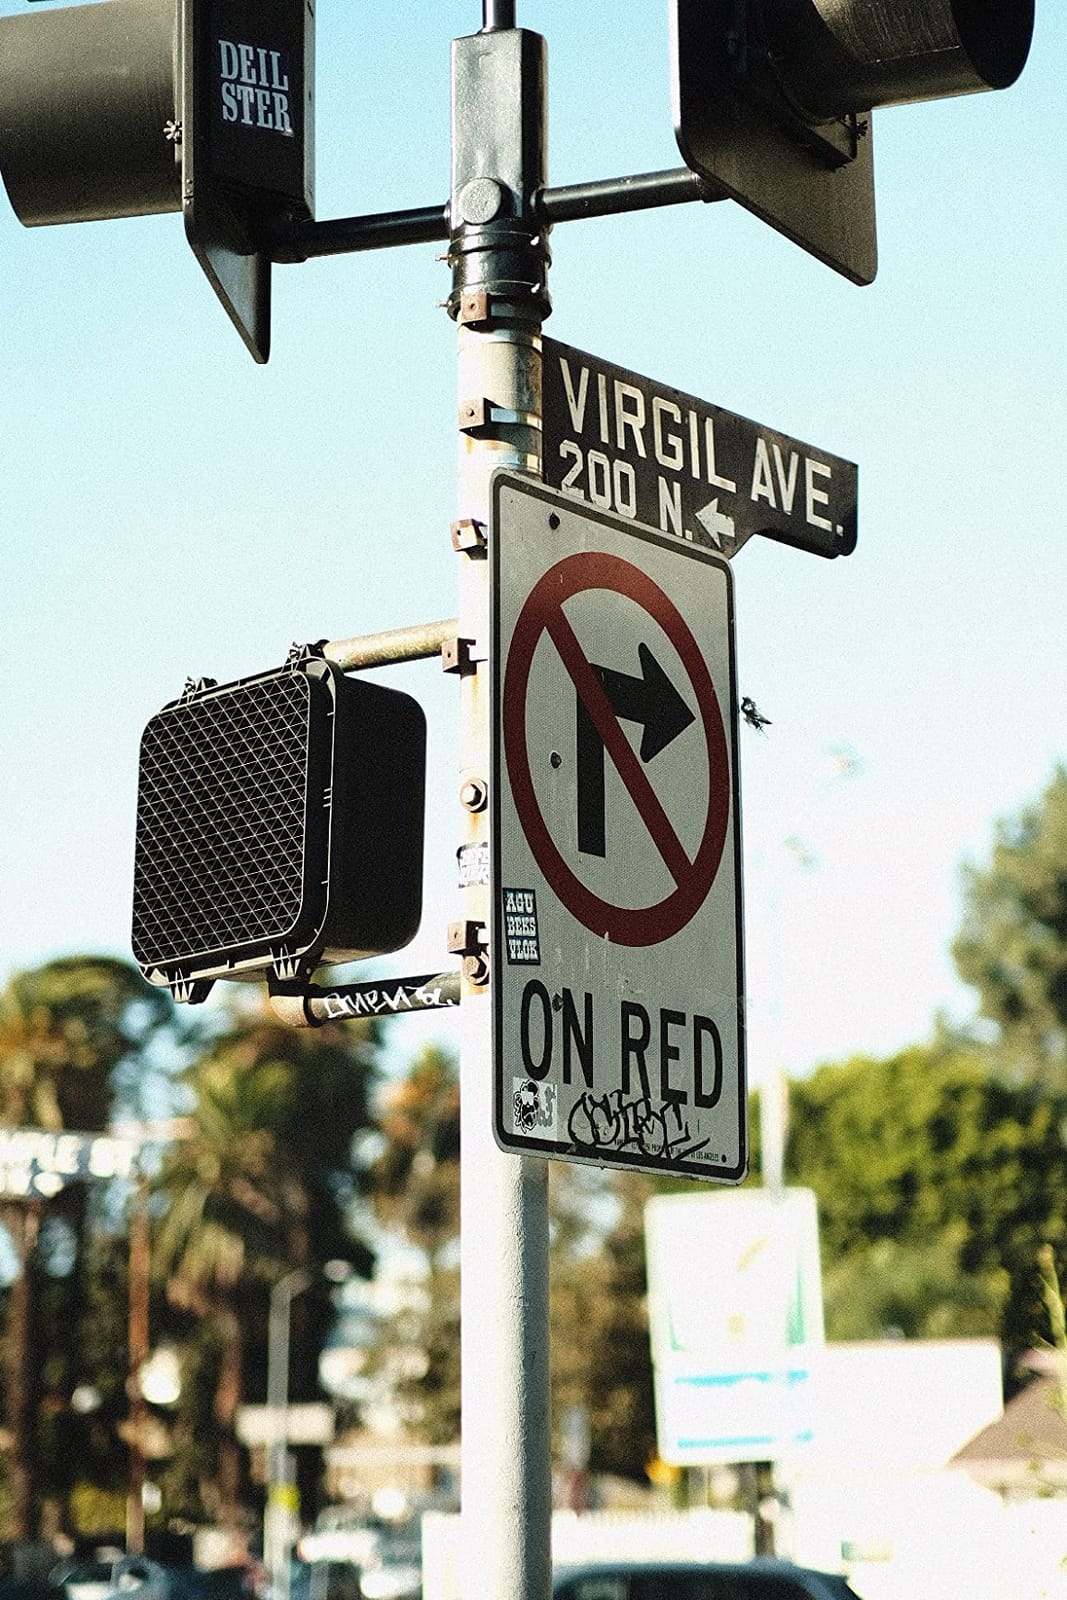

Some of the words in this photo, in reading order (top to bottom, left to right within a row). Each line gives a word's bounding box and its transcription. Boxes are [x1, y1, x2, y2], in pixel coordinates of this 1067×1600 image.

[218, 39, 289, 91] DEIL
[221, 81, 292, 133] STER
[559, 357, 737, 493] VIRGIL
[750, 437, 844, 537] AVE.
[559, 439, 637, 520] 200
[658, 475, 693, 541] N.
[506, 891, 534, 914] AGU
[520, 978, 594, 1089] ON
[621, 1000, 723, 1109] RED
